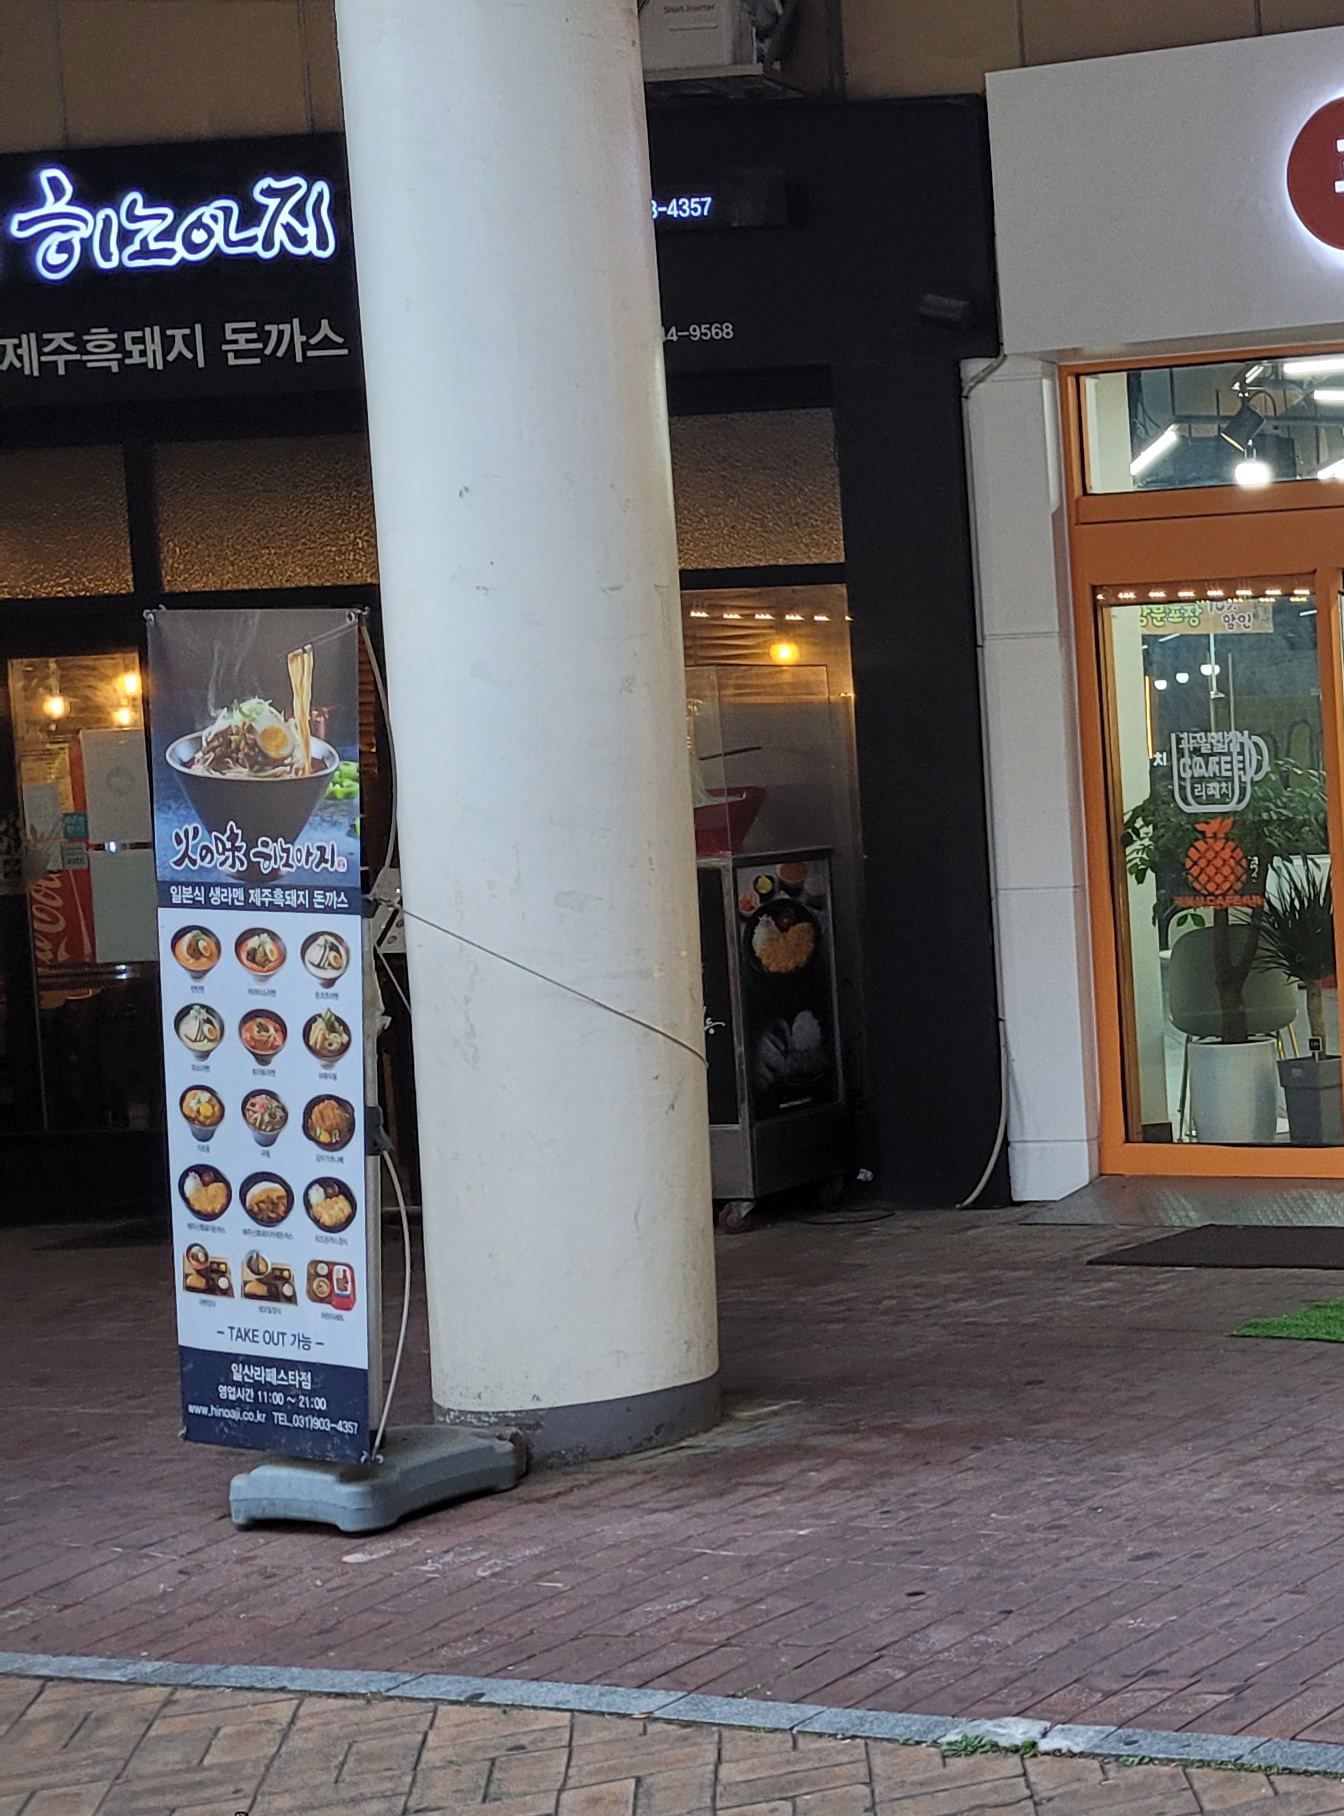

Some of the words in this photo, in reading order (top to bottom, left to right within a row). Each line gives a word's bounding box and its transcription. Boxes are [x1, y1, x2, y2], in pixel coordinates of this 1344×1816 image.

[662, 322, 734, 344] 4-9568
[0, 322, 205, 378] 제주흑돼지
[221, 317, 349, 366] 돈까스
[169, 885, 206, 905] 일본식
[208, 886, 245, 906] 생라멘
[248, 888, 310, 908] 제주흑돼지
[312, 890, 349, 909] 돈까스
[227, 1326, 260, 1344] TAKE
[262, 1329, 288, 1348] OUT
[290, 1332, 313, 1351] 가능
[230, 1362, 312, 1390] 일산라페스타점
[217, 1384, 255, 1403] 영업시간
[257, 1389, 285, 1406] 11:00
[299, 1394, 327, 1412] 21:00
